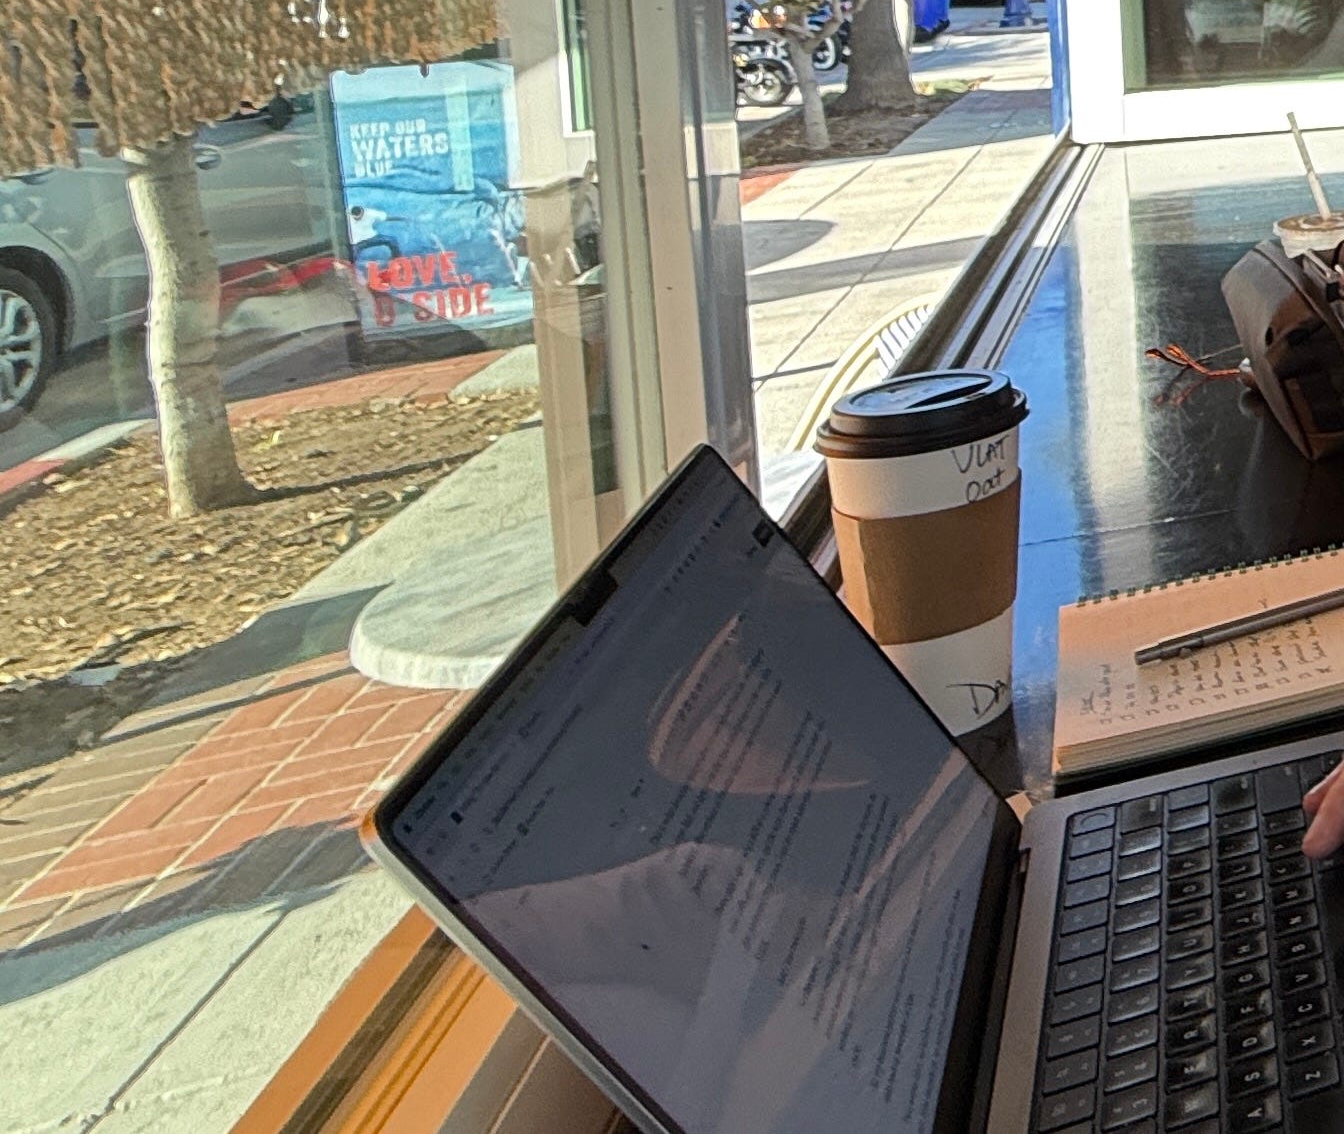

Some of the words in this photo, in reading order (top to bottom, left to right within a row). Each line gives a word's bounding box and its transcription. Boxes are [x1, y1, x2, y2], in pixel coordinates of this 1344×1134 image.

[350, 121, 390, 139] KEEP
[395, 118, 426, 135] OUR
[351, 132, 450, 163] WATERS
[354, 160, 394, 178] BLUE
